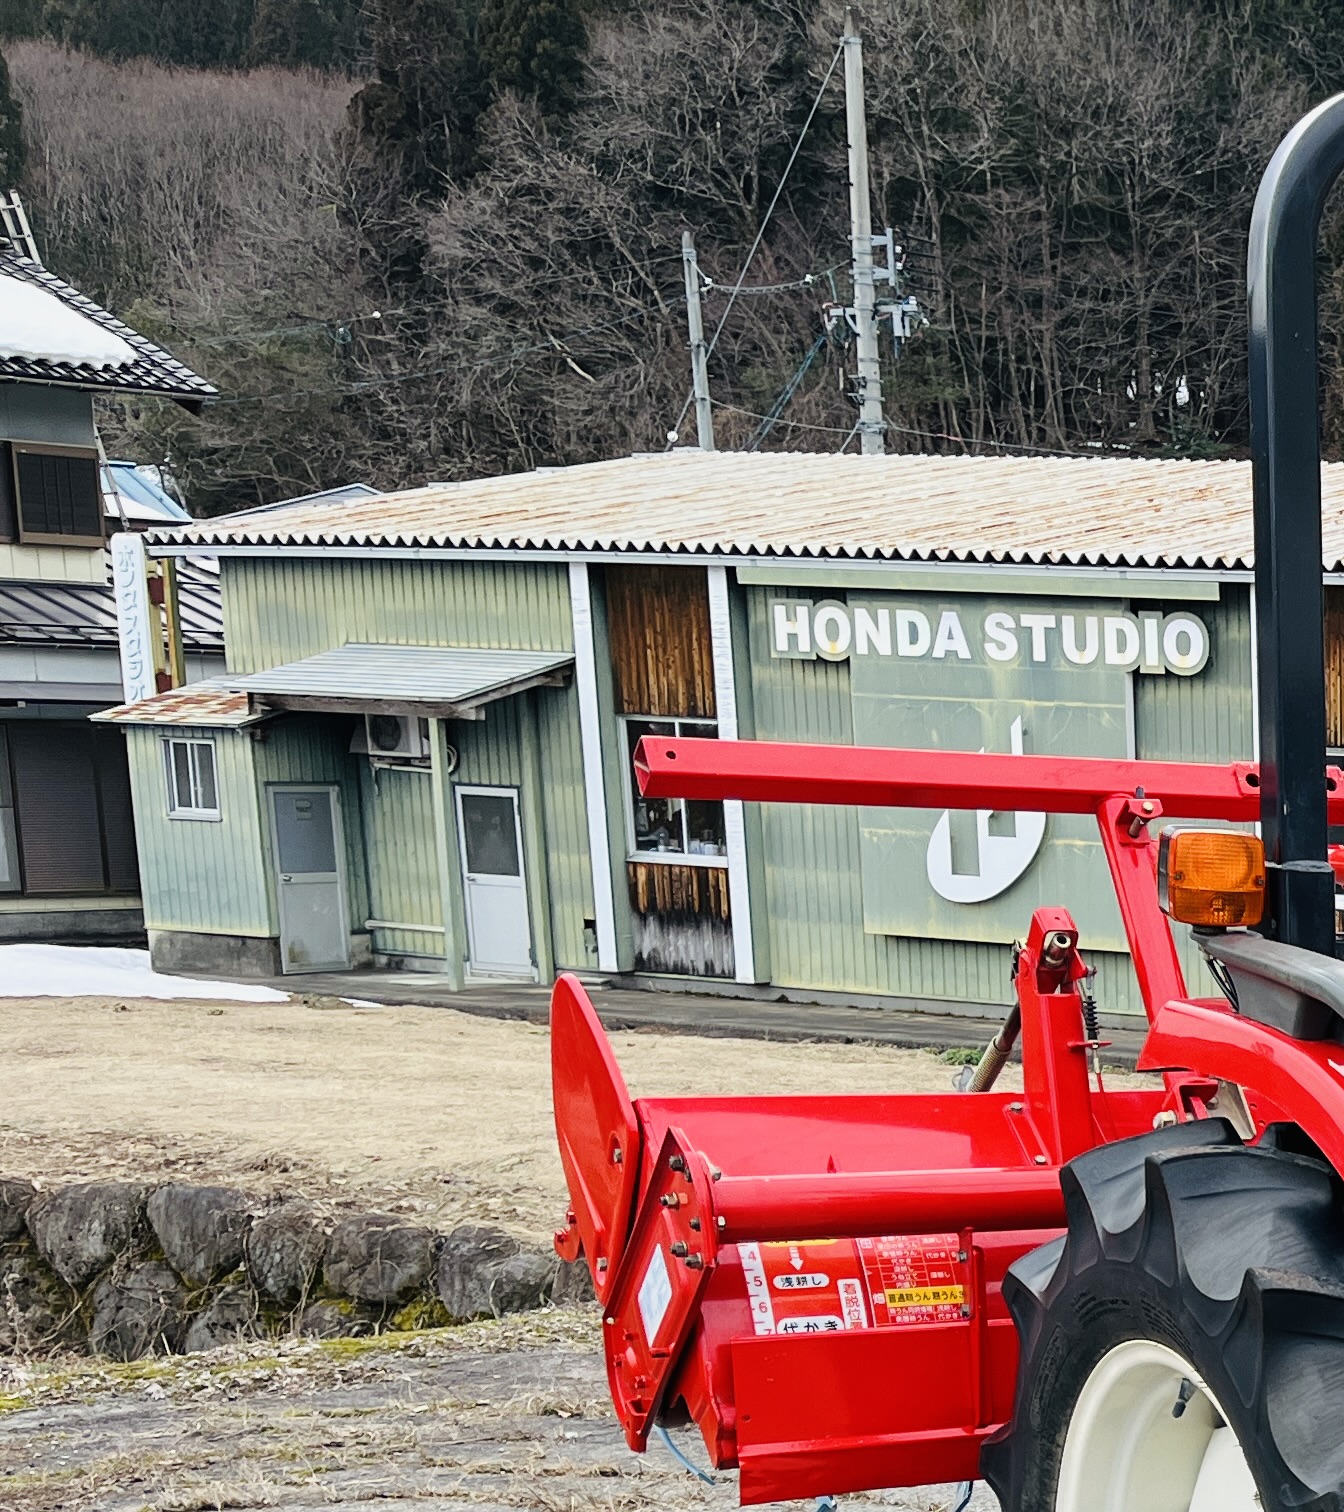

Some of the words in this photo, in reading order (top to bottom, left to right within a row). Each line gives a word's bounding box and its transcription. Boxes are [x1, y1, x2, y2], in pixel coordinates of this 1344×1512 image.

[773, 603, 972, 660] HONDA
[983, 611, 1204, 669] STUDIO
[753, 1276, 763, 1287] 5
[758, 1301, 768, 1313] 6
